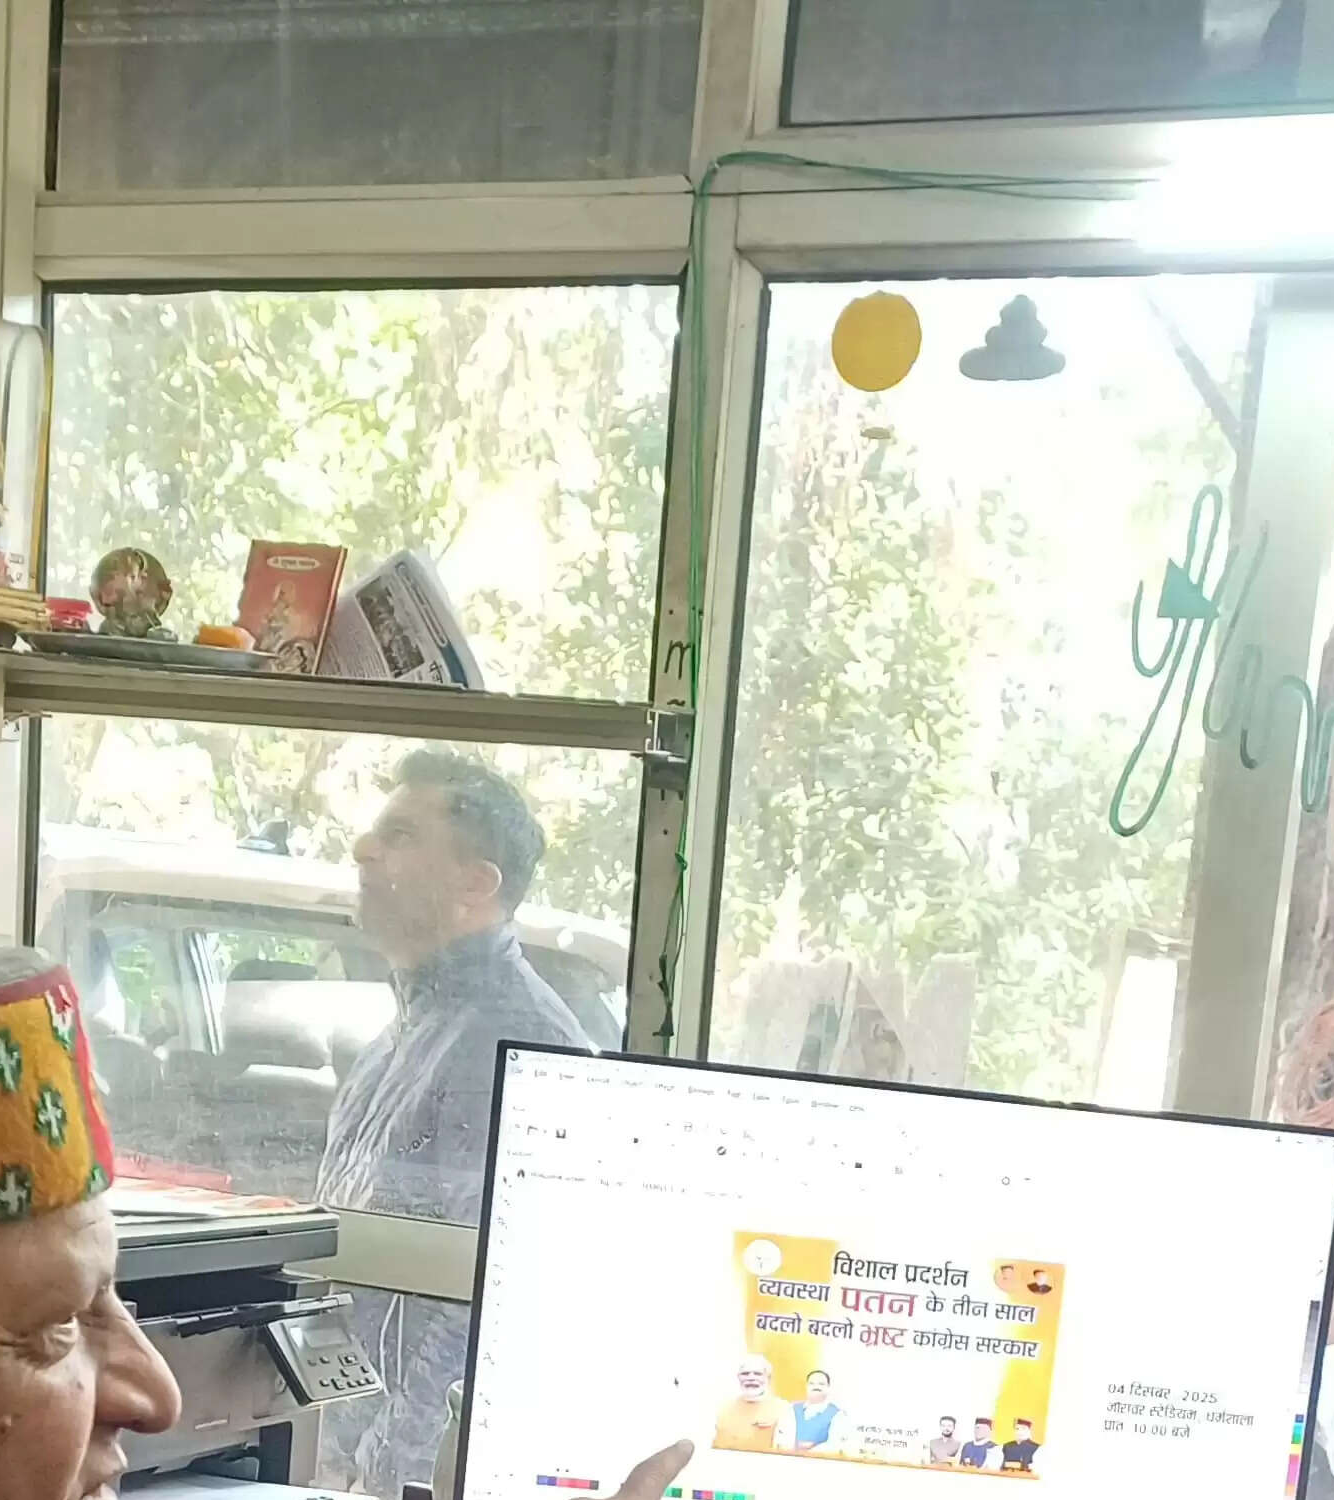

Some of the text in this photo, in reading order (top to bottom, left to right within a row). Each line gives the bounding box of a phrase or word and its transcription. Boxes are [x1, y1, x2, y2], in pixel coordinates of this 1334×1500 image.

[832, 1250, 970, 1289] विशाल प्रदर्शन
[758, 1277, 1037, 1323] व्यवस्था पतन के तीन साल
[755, 1312, 1039, 1360] बदलो बदलो भ्रष्ट कांग्रेस सरकार
[1107, 1383, 1125, 1395] 04
[1181, 1390, 1219, 1404] 2025
[1171, 1424, 1191, 1439] बजे
